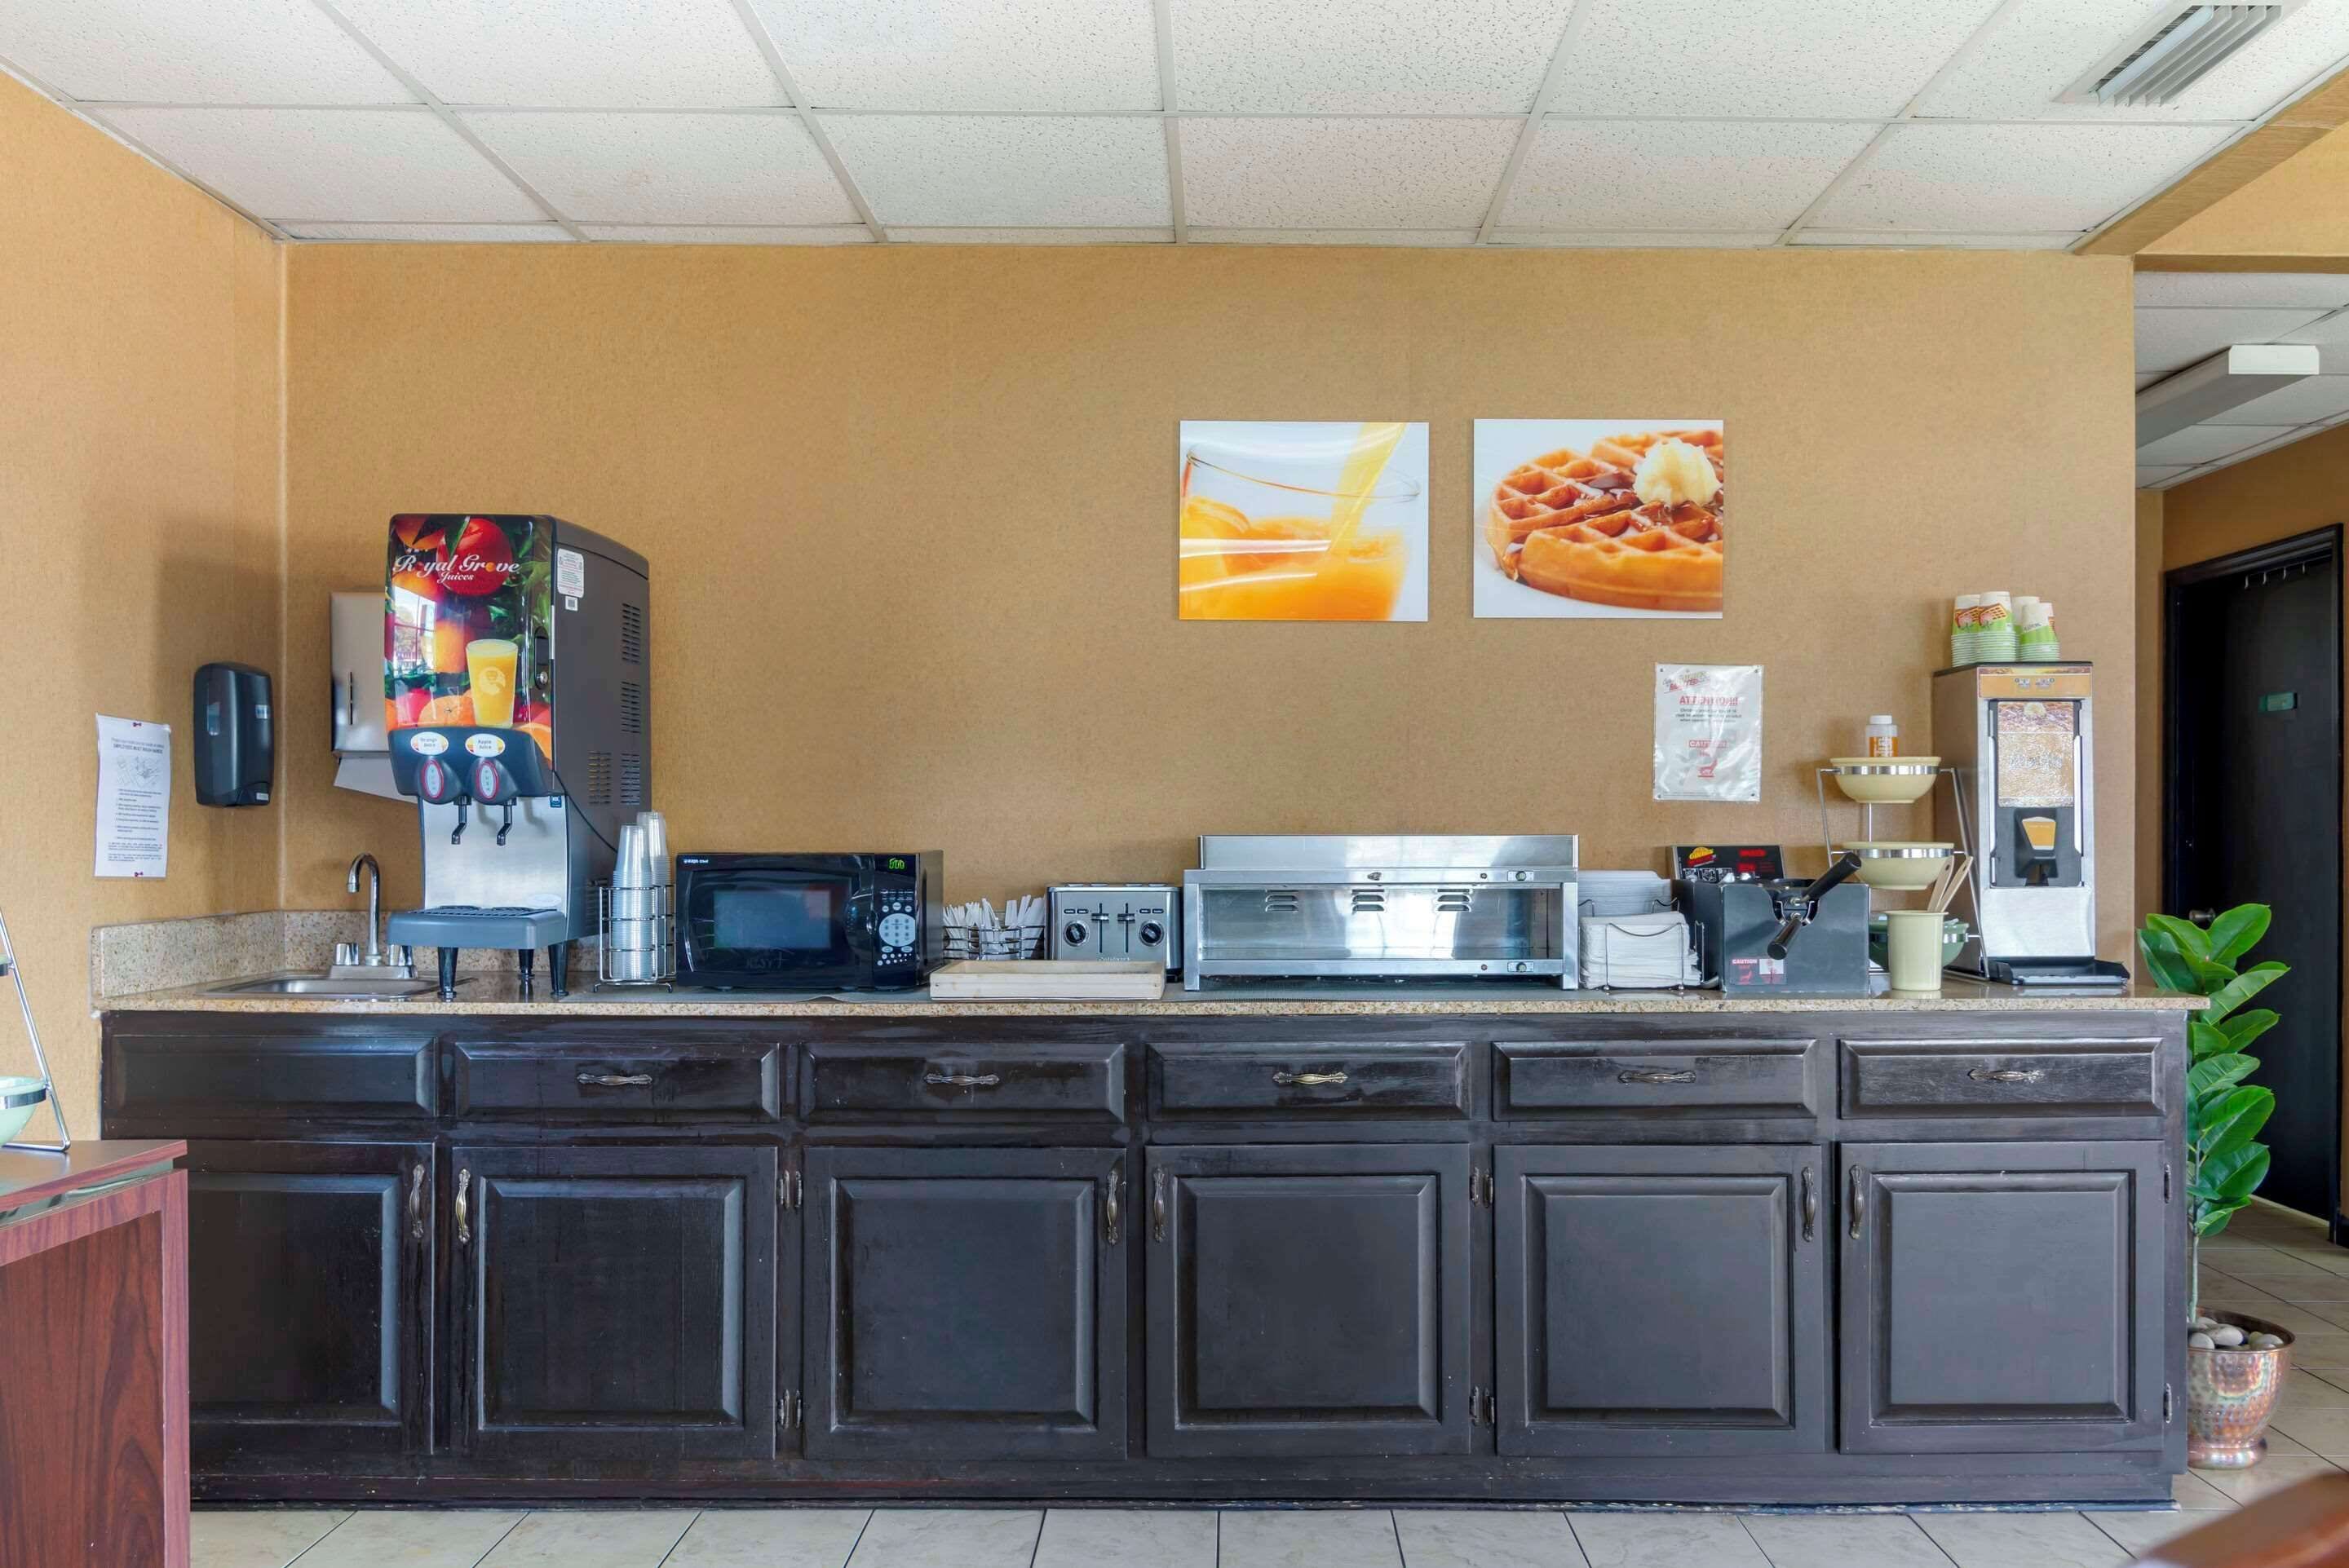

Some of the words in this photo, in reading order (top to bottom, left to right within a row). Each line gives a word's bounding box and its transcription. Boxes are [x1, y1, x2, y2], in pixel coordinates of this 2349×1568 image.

[392, 554, 458, 578] Royal
[458, 554, 522, 572] Grove
[436, 571, 475, 584] Juices
